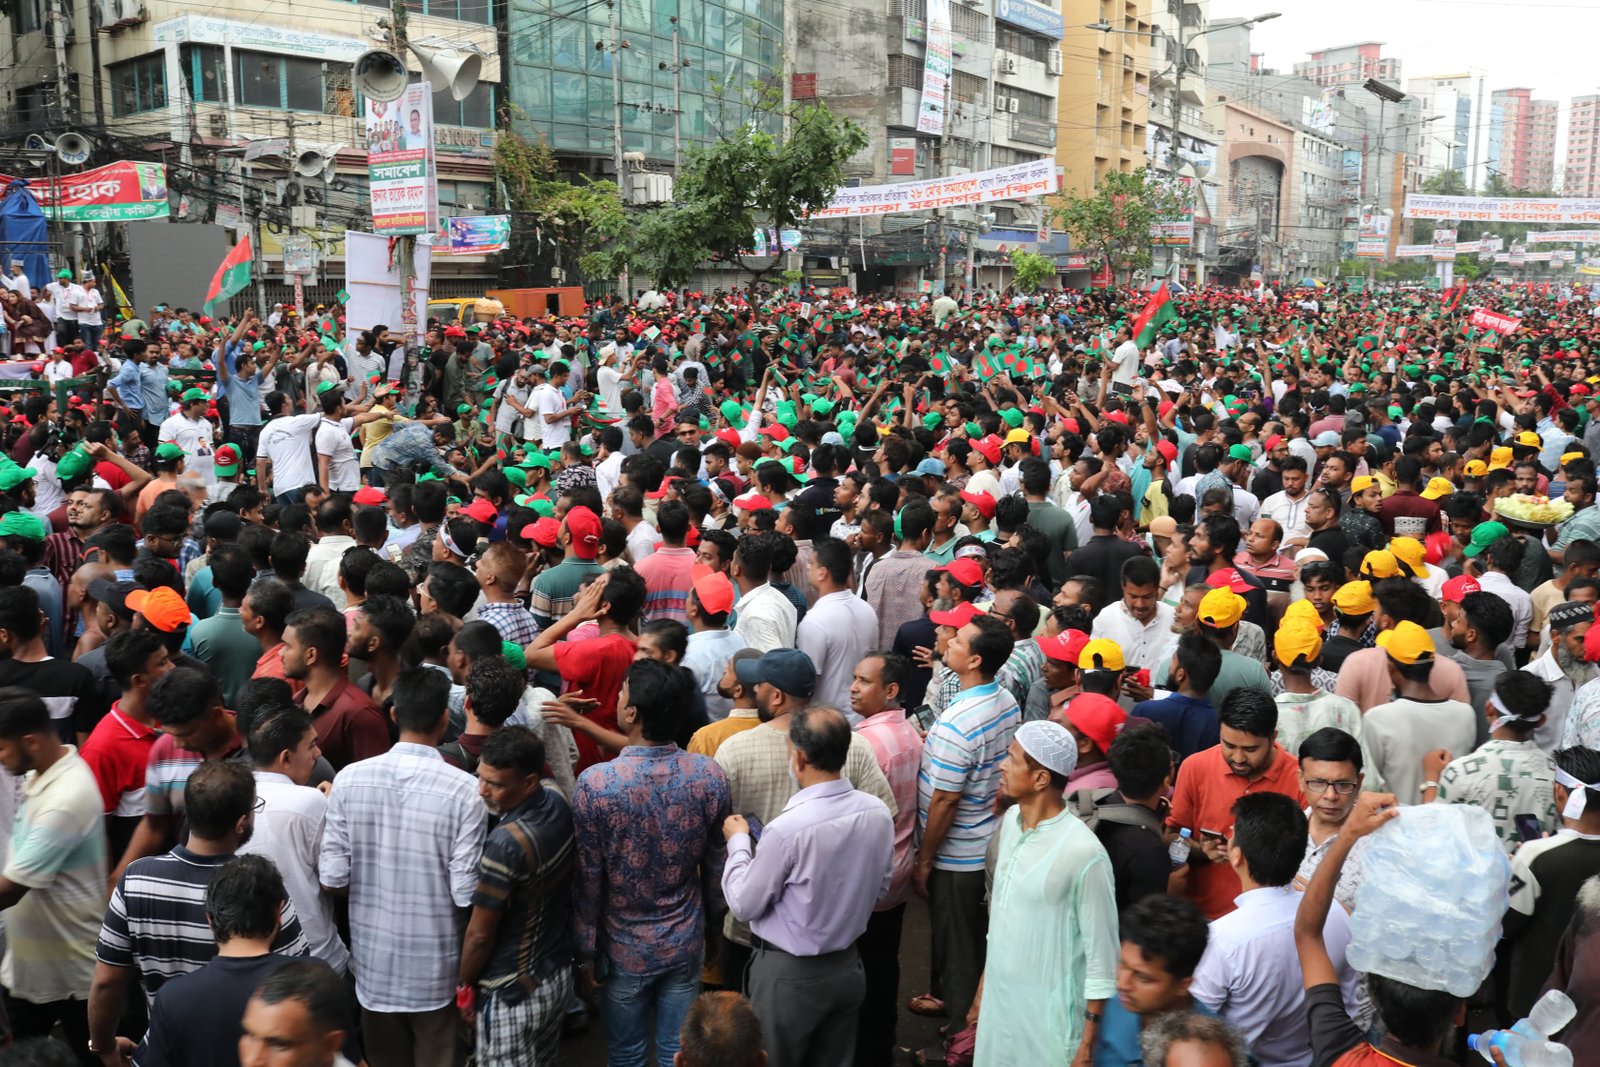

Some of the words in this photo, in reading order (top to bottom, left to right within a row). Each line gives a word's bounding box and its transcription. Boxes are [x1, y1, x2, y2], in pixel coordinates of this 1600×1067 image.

[372, 164, 422, 179] সমাবেশ
[69, 179, 121, 200] হোক
[907, 192, 983, 209] মহানগর
[991, 179, 1050, 197] দক্ষিণ
[910, 188, 923, 200] ২৮
[124, 204, 158, 216] কমিটি
